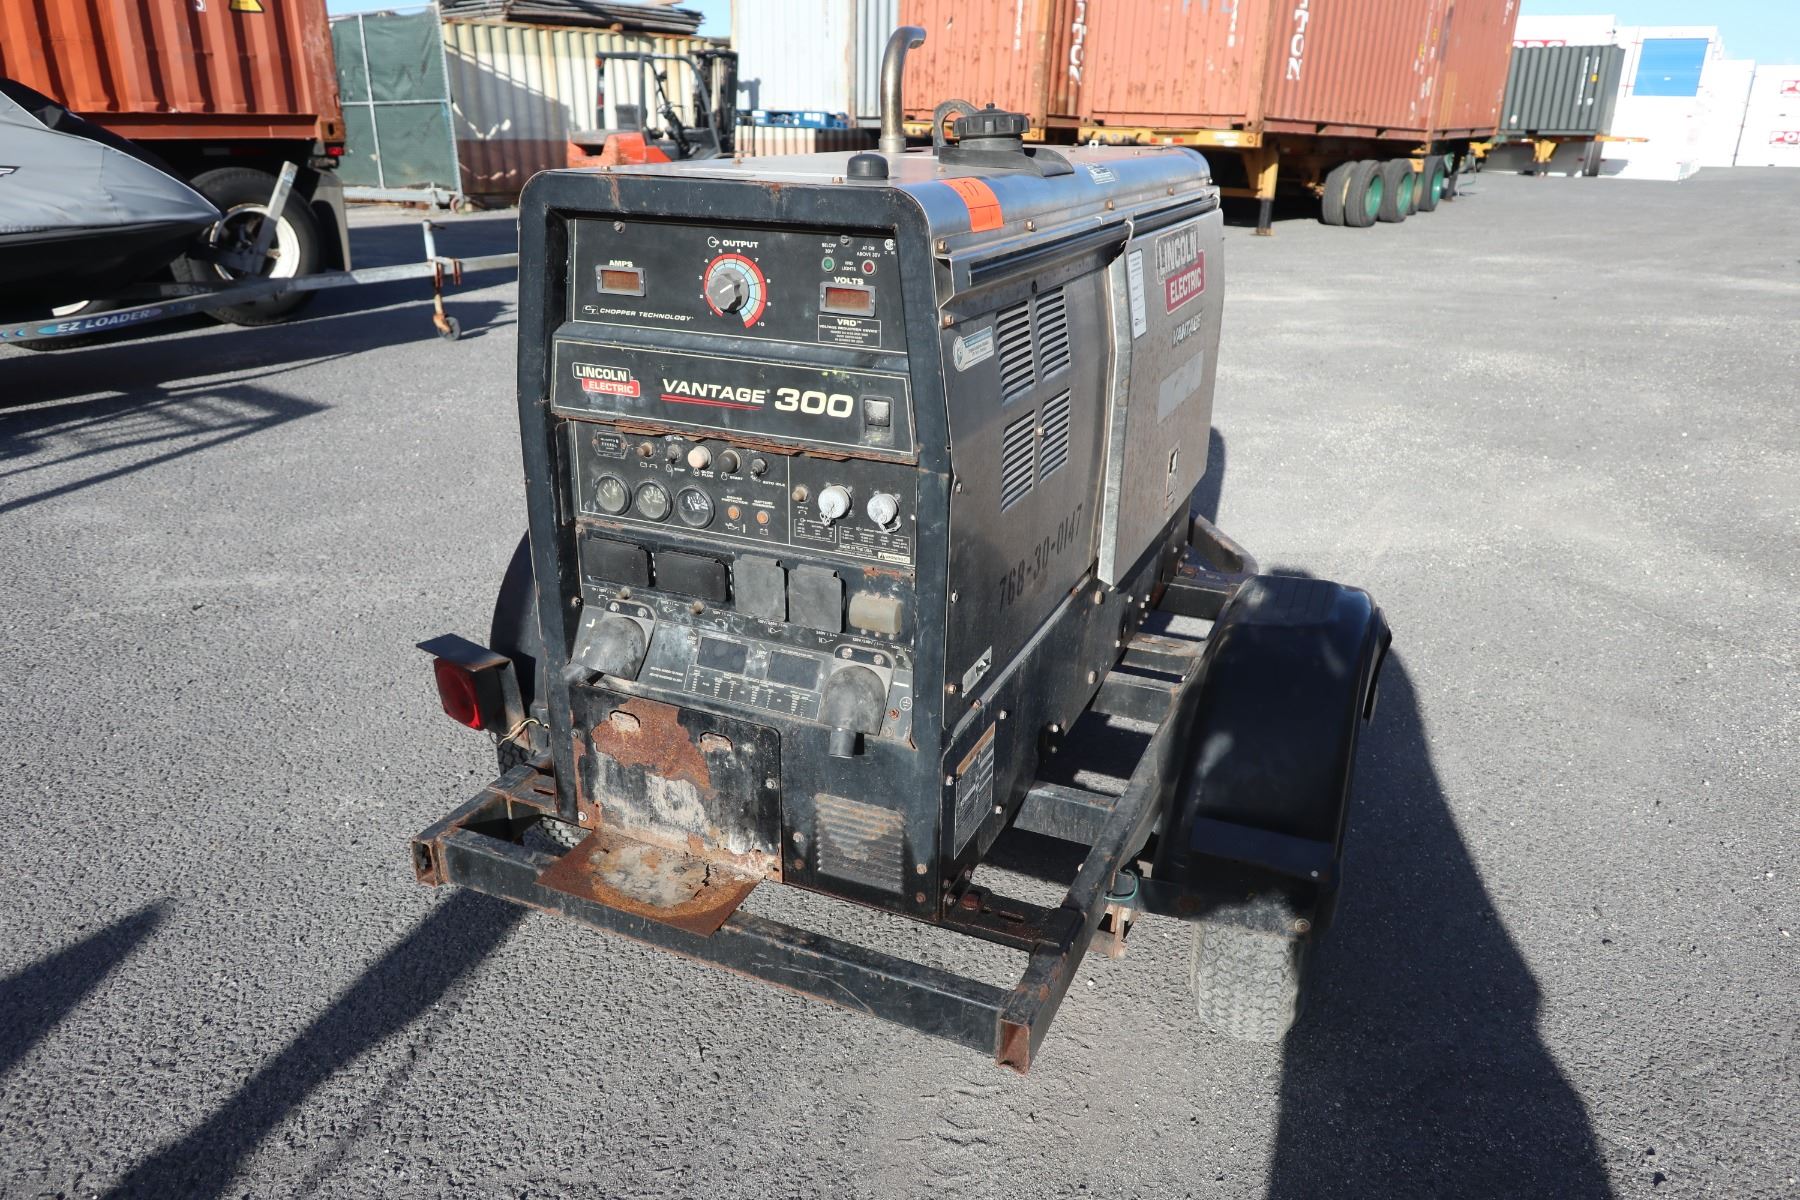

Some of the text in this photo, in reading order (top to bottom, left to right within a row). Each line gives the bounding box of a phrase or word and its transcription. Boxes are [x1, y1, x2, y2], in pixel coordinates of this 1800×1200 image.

[723, 240, 759, 248] OUTPUT
[1159, 231, 1197, 275] LINCOLN
[609, 259, 634, 267] AMPS
[834, 276, 864, 285] VOLTS
[1170, 267, 1201, 304] ELECTRIC
[55, 309, 151, 334] EZ LOADER
[600, 308, 636, 317] CHOPPER
[639, 311, 692, 321] TECHNOLOGY
[836, 318, 857, 327] VRD
[576, 365, 627, 382] LINCOLN
[588, 380, 634, 394] ELECTRIC
[662, 378, 854, 418] VANTAGE 300
